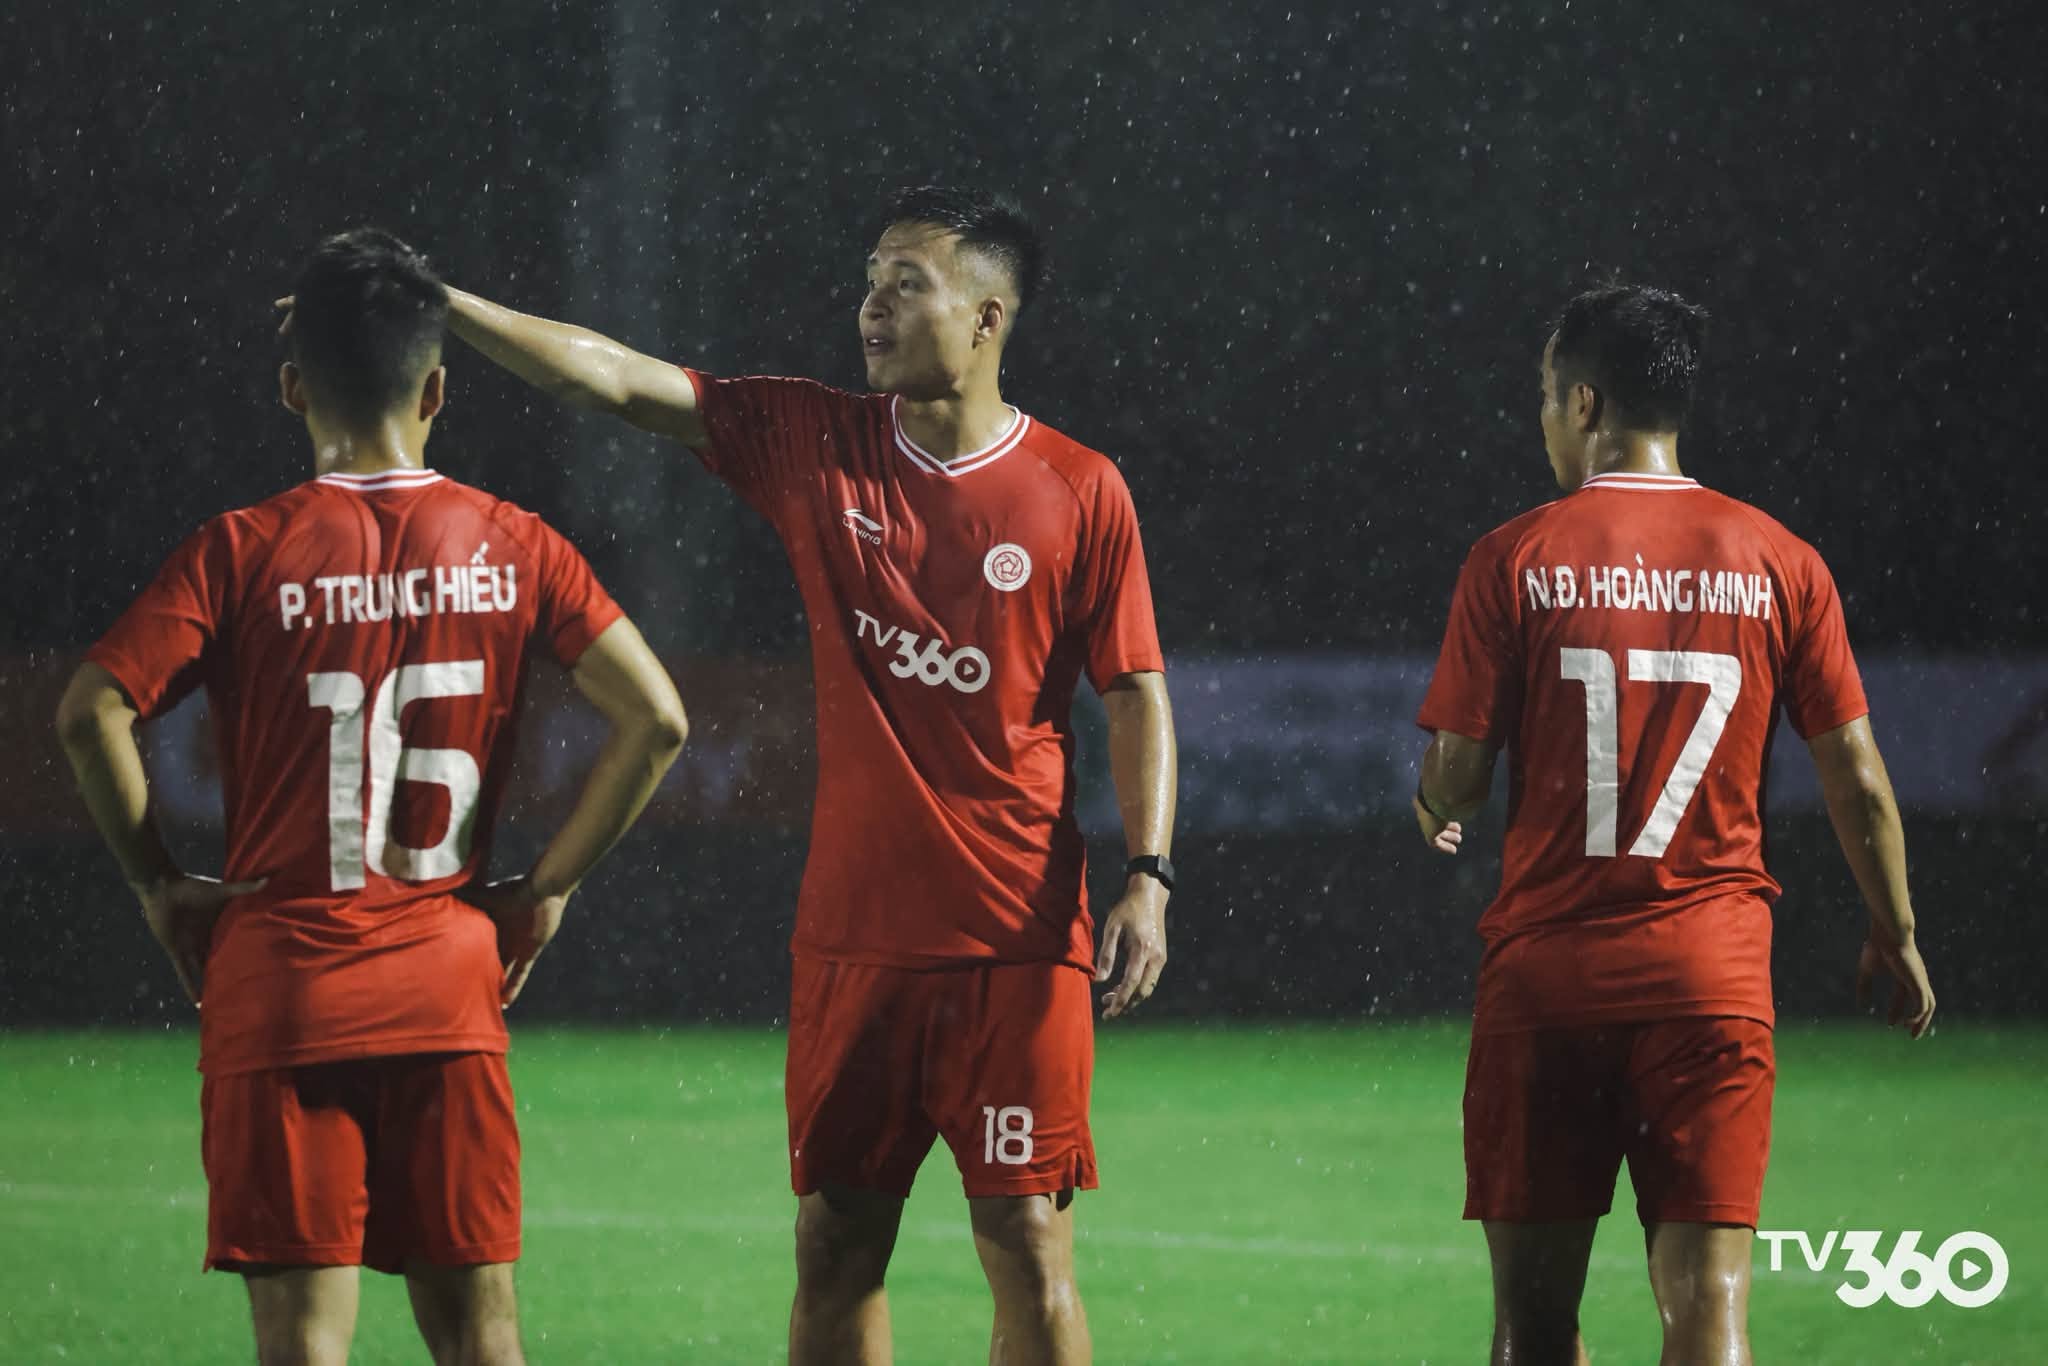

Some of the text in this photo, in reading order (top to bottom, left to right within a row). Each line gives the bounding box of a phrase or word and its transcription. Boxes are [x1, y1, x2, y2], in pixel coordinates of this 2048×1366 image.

[280, 541, 516, 631] P. TRUNG HIẾU
[1589, 553, 1692, 613] HOÀNG
[1699, 570, 1771, 620] MINH
[306, 659, 484, 892] 16
[1560, 647, 1742, 858] 17
[983, 1105, 1034, 1165] 18
